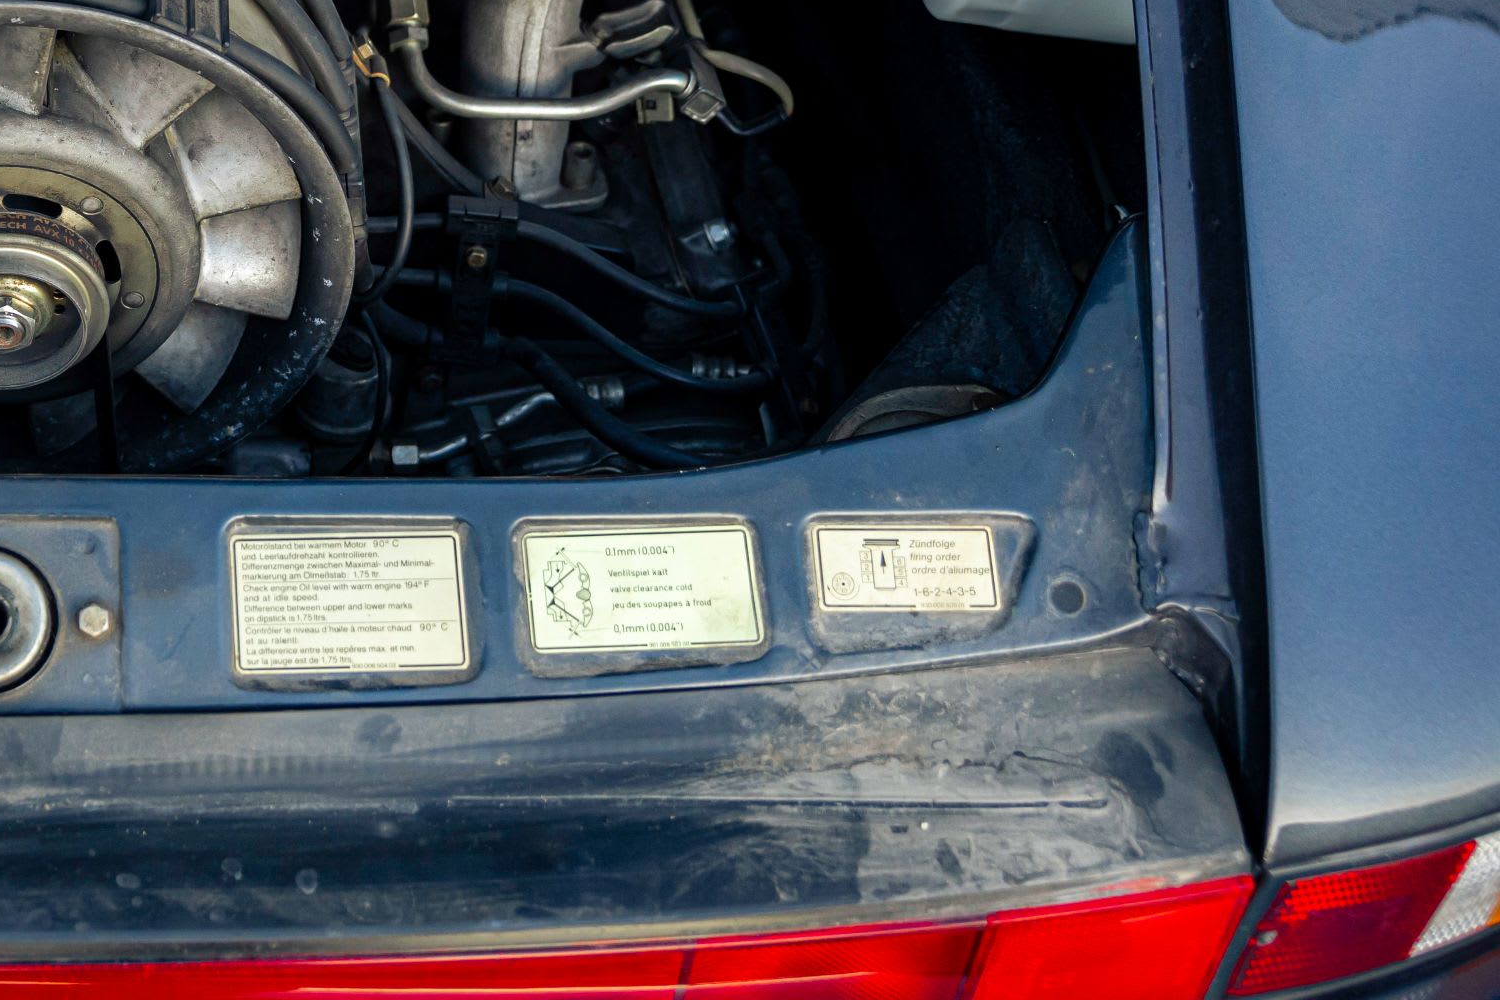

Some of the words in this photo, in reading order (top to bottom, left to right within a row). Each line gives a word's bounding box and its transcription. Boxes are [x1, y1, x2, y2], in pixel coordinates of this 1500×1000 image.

[344, 541, 367, 549] Motor
[908, 539, 956, 550] Zündfolge
[241, 553, 256, 561] und
[910, 552, 933, 563] firing
[935, 552, 961, 561] order
[306, 561, 343, 569] zwischen
[383, 560, 399, 568] und
[607, 568, 650, 579] Ventilspiel
[911, 566, 937, 575] ordre
[242, 573, 287, 582] markierung
[242, 584, 268, 592] Check
[270, 584, 298, 594] engine
[312, 583, 331, 592] level
[333, 582, 349, 591] with
[374, 582, 402, 591] engine
[610, 584, 631, 593] valve
[633, 584, 674, 593] clearance
[675, 583, 693, 591] cold
[243, 593, 260, 602] and
[244, 604, 285, 613] Difference
[286, 603, 321, 612] between
[322, 603, 346, 613] upper
[347, 602, 363, 611] and
[364, 602, 385, 610] lower
[387, 602, 413, 610] marks
[612, 601, 625, 611] jeu
[626, 600, 642, 609] des
[643, 600, 683, 610] soupapes
[692, 598, 712, 607] froid
[293, 625, 320, 633] niveau
[357, 624, 385, 632] moteur
[387, 624, 412, 632] chaud
[270, 657, 293, 667] jauge
